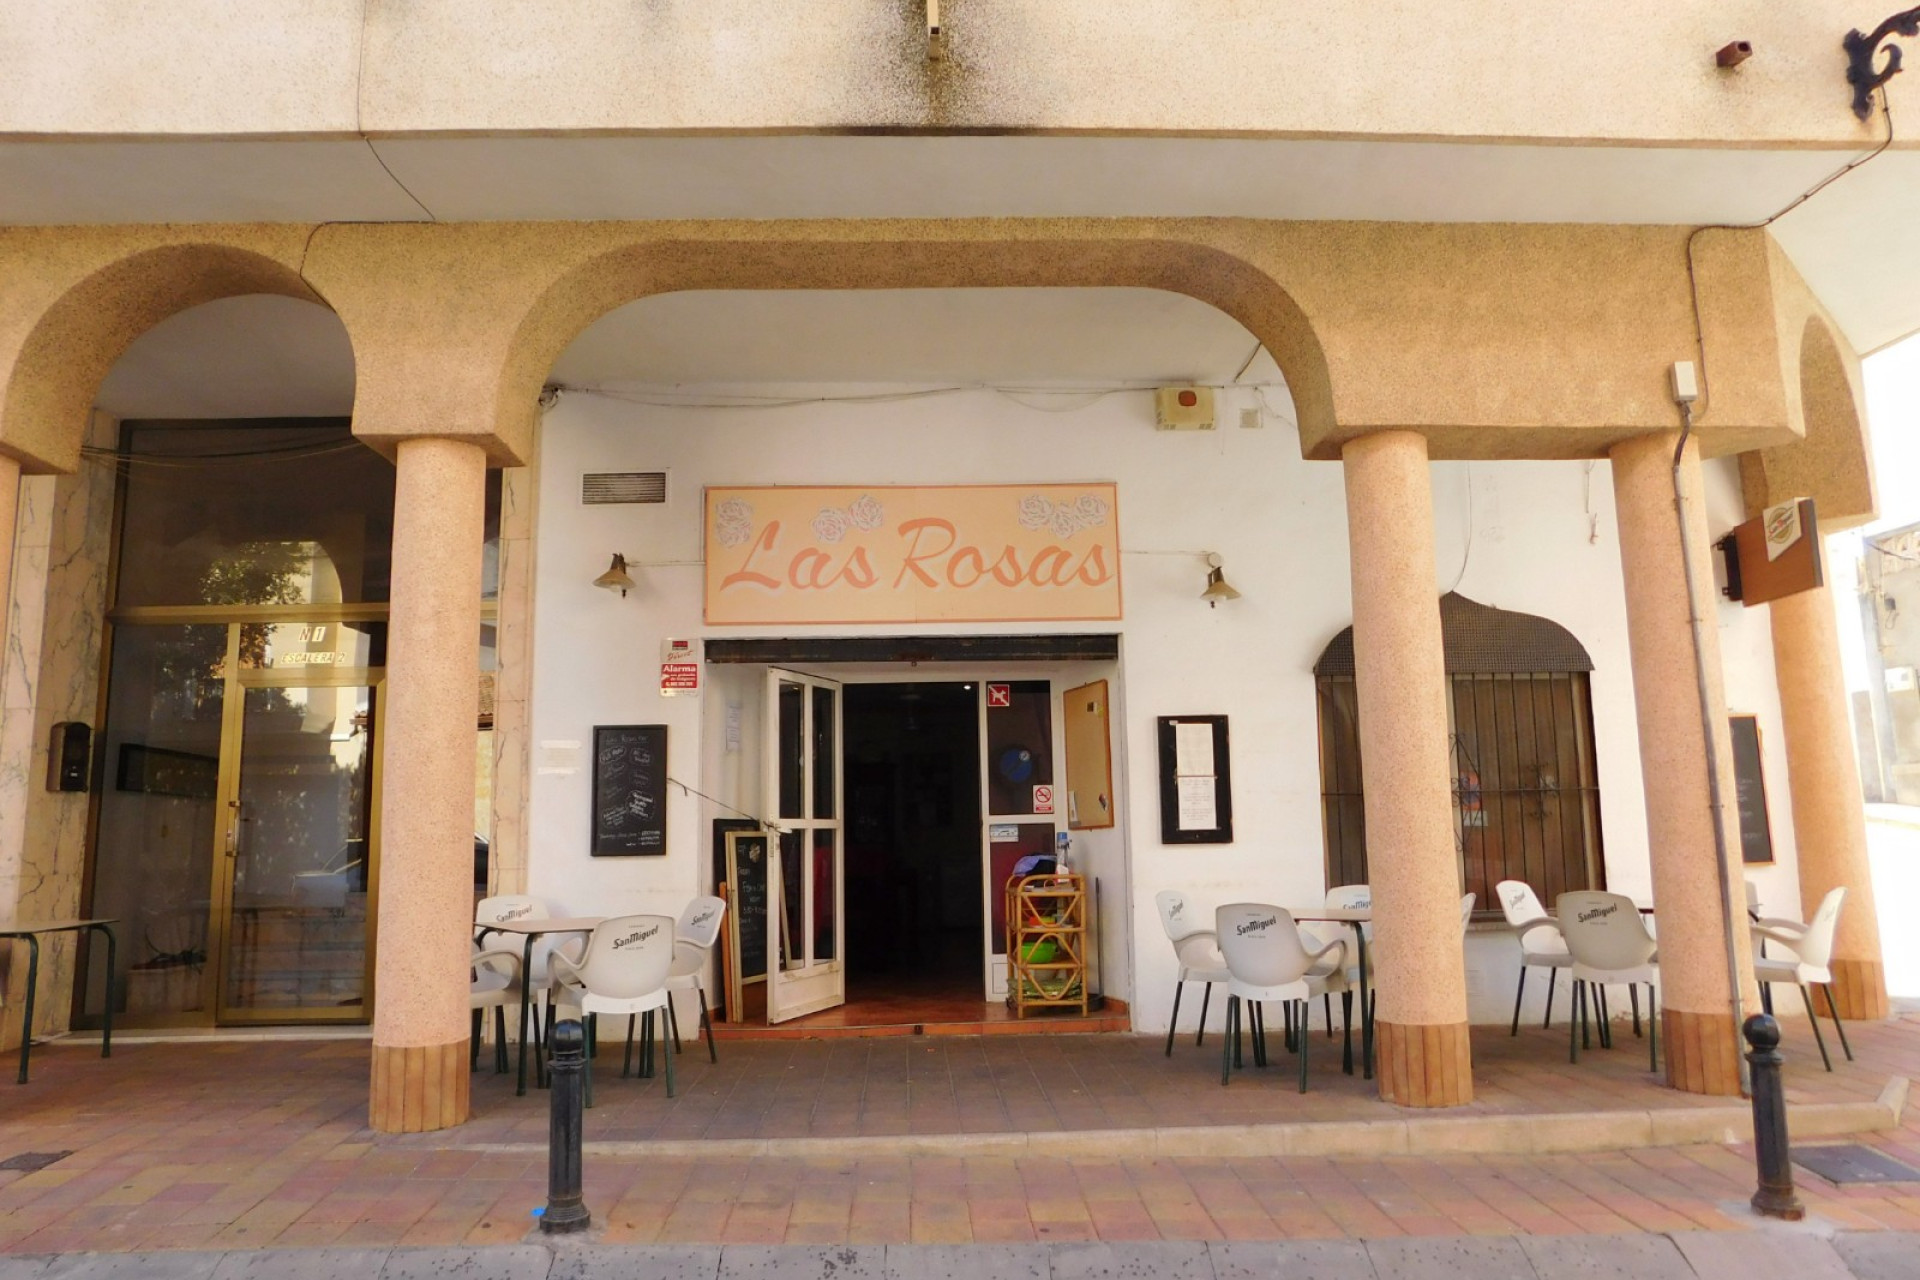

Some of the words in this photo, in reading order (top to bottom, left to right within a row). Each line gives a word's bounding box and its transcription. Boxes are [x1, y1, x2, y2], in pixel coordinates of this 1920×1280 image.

[719, 519, 880, 592] Las
[893, 517, 1114, 589] Rosas
[281, 652, 335, 663] ESCALERA
[338, 652, 346, 663] 2
[662, 664, 697, 673] Alarma
